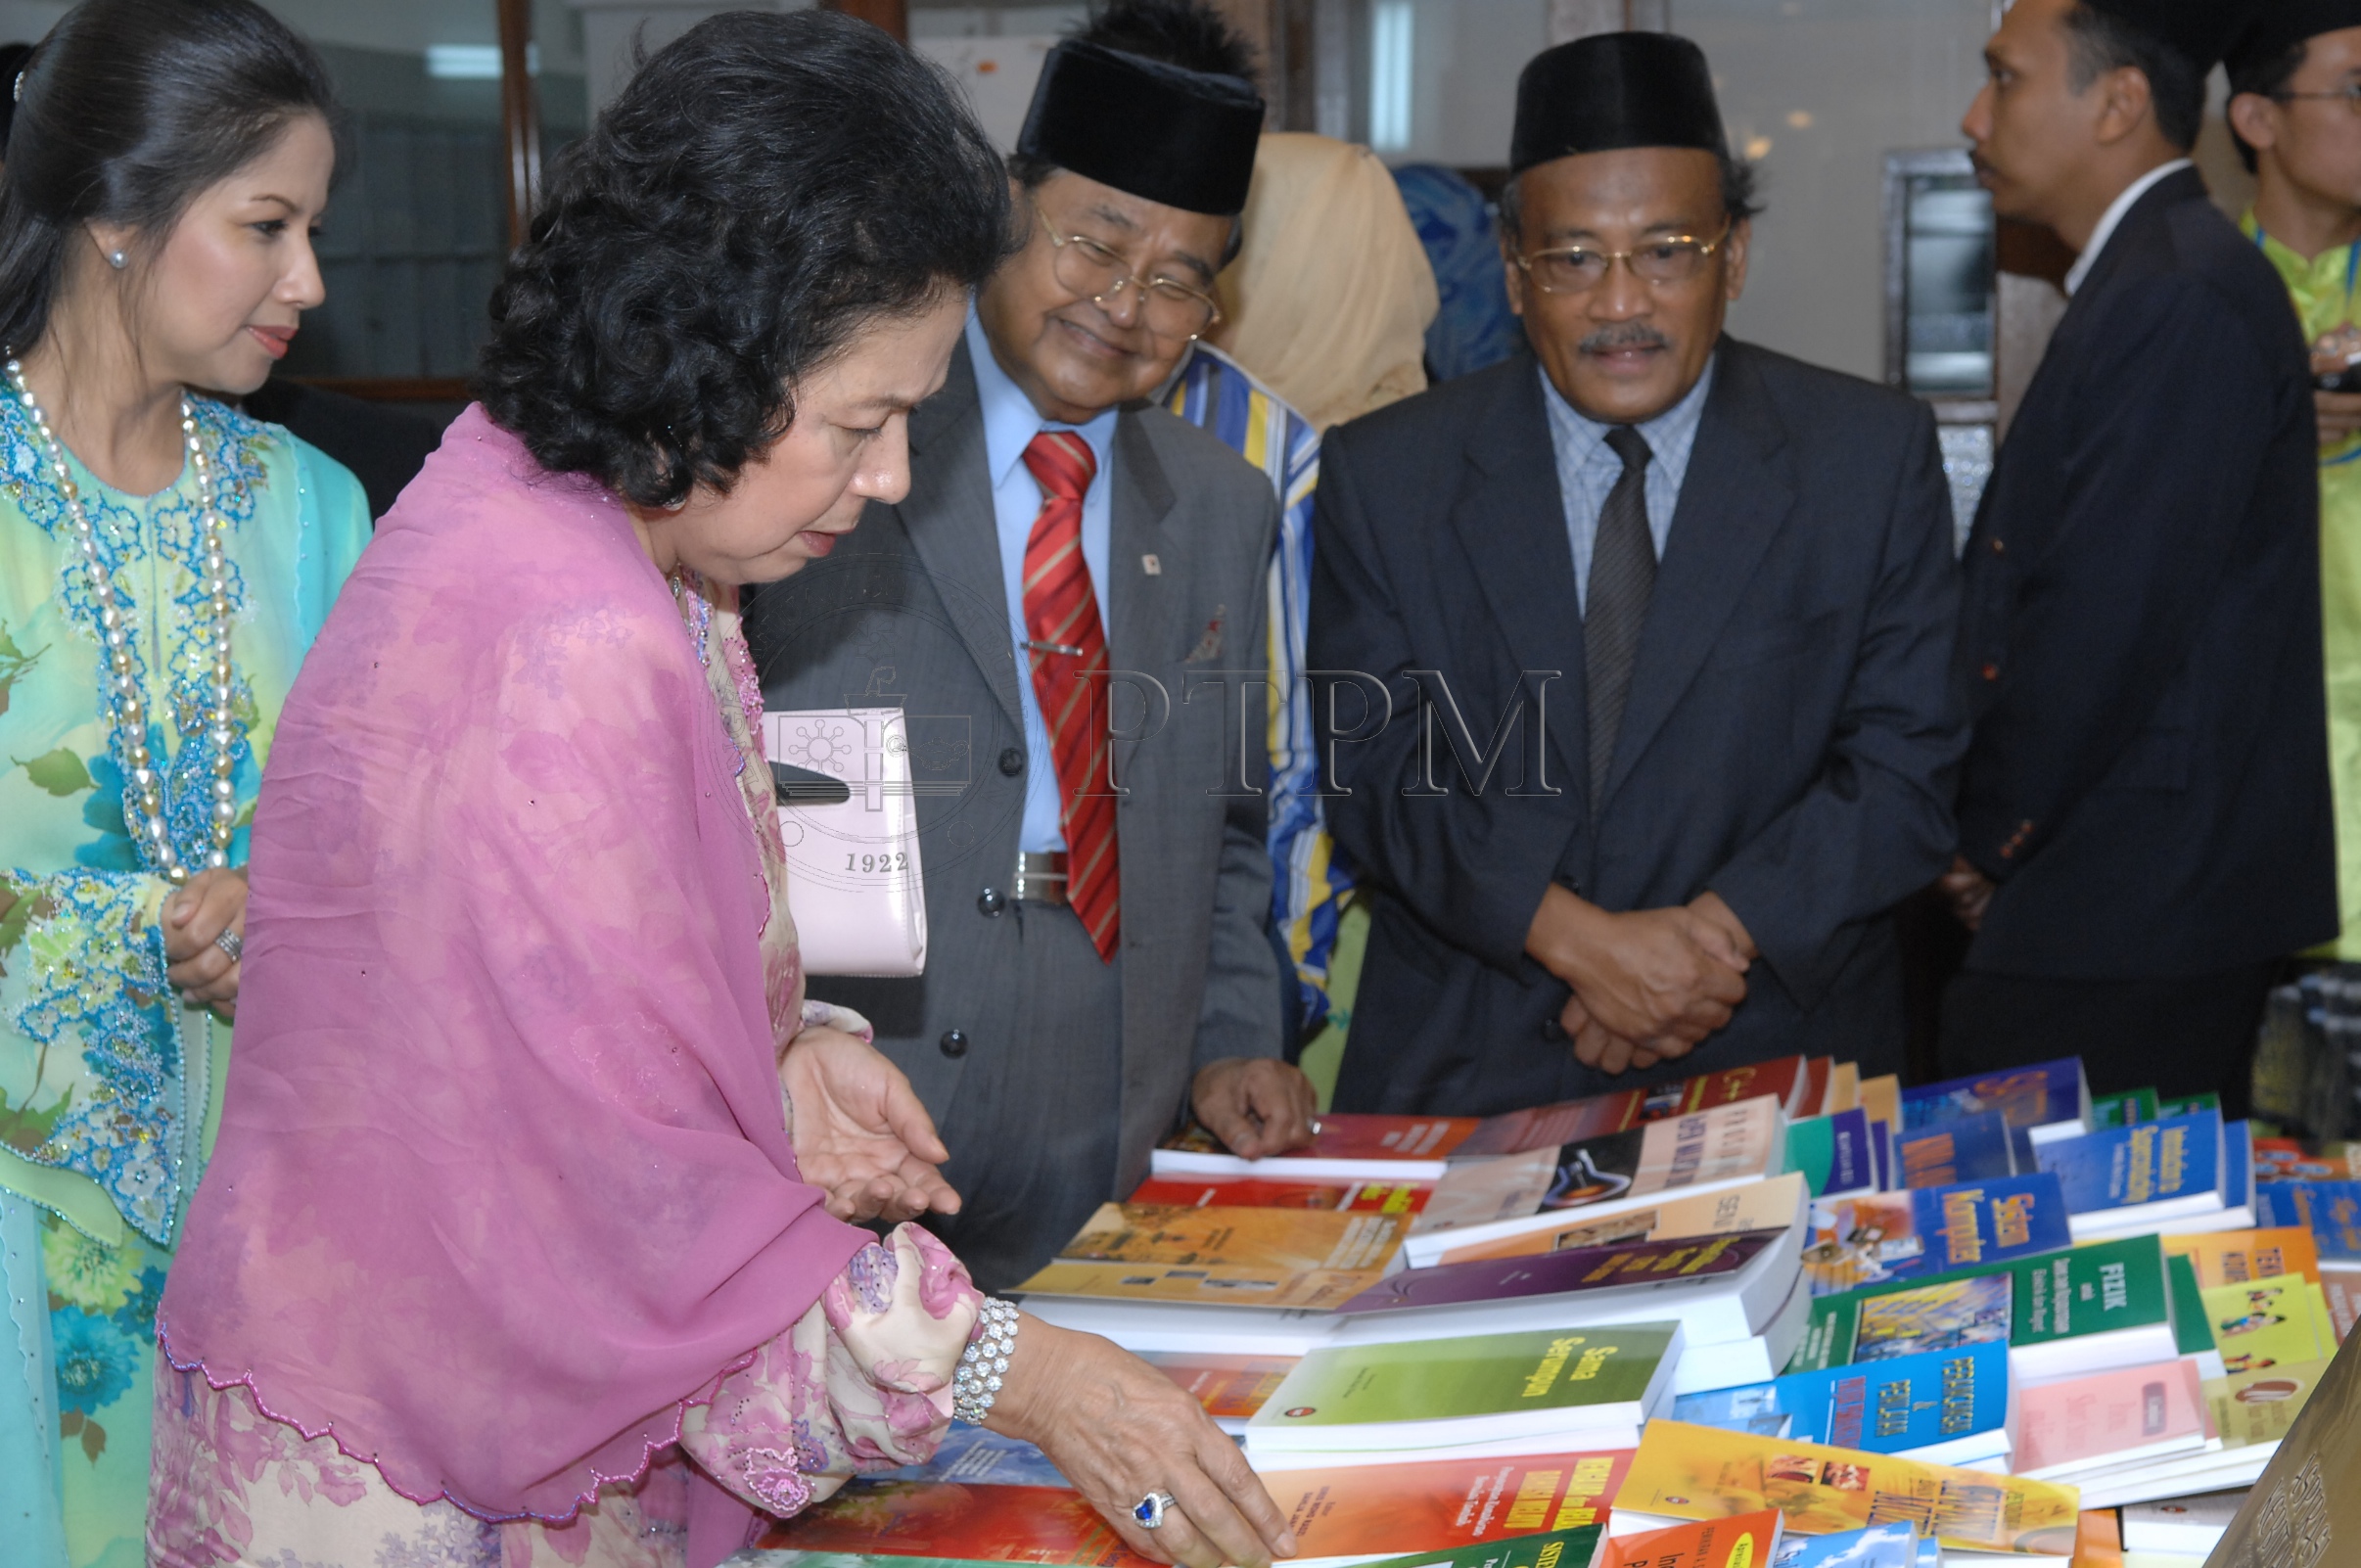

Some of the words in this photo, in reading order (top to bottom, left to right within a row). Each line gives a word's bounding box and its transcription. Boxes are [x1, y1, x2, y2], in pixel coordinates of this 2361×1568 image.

[1935, 1188, 1986, 1265] Komputer
[2099, 1262, 2127, 1312] FIZIK
[1521, 1337, 1586, 1398] Serumpun
[1569, 1346, 1619, 1381] Sama
